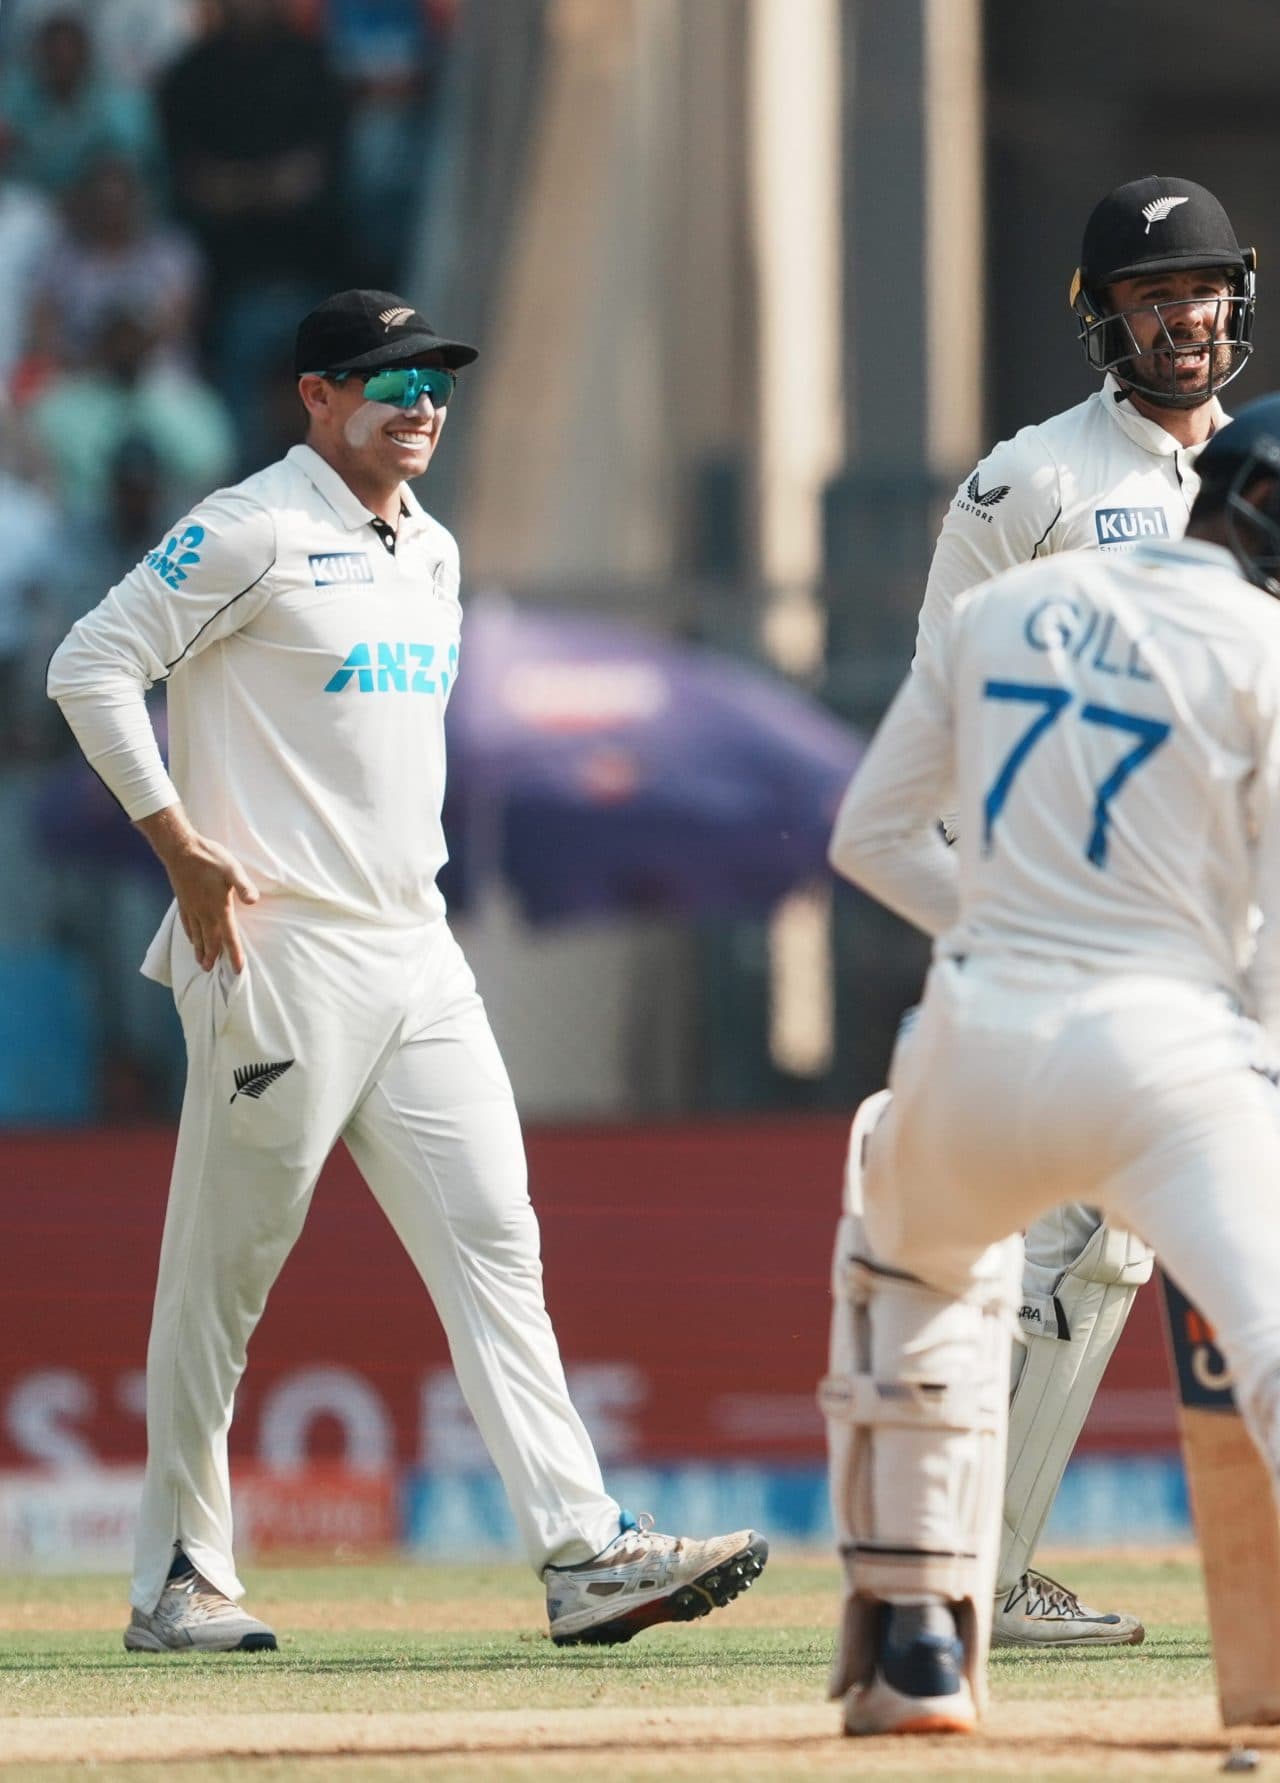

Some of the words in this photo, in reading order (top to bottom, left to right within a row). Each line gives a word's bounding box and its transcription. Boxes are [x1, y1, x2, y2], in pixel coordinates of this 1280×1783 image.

[956, 499, 994, 524] CASTORE
[323, 641, 436, 694] ANZ
[1023, 598, 1156, 682] GILL
[982, 678, 1172, 871] 77
